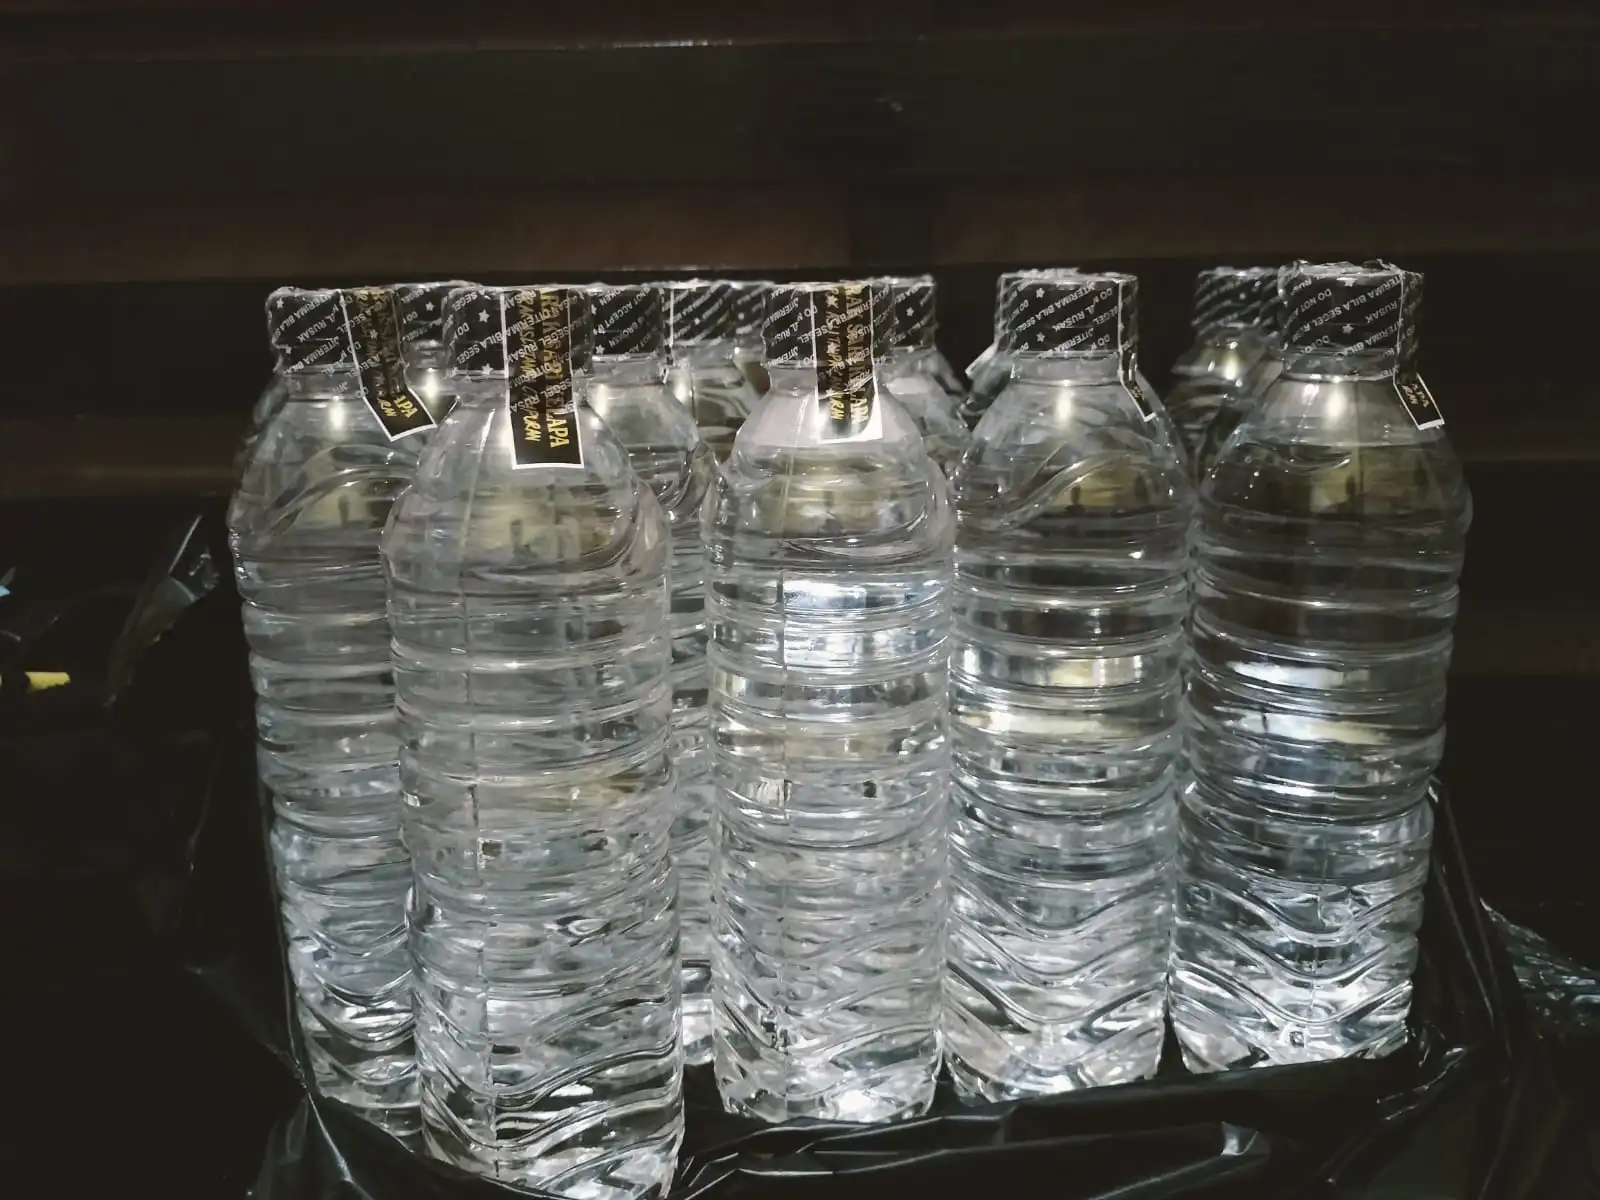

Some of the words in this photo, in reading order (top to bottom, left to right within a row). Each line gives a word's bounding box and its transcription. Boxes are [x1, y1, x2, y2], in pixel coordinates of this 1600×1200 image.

[1317, 288, 1331, 300] DO
[1342, 294, 1366, 312] BILA
[604, 302, 633, 327] ACCEPT
[1052, 311, 1084, 332] RUSAK
[1312, 306, 1342, 327] SEGEL
[1364, 301, 1398, 323] RUSAK
[297, 319, 327, 343] RUSAK
